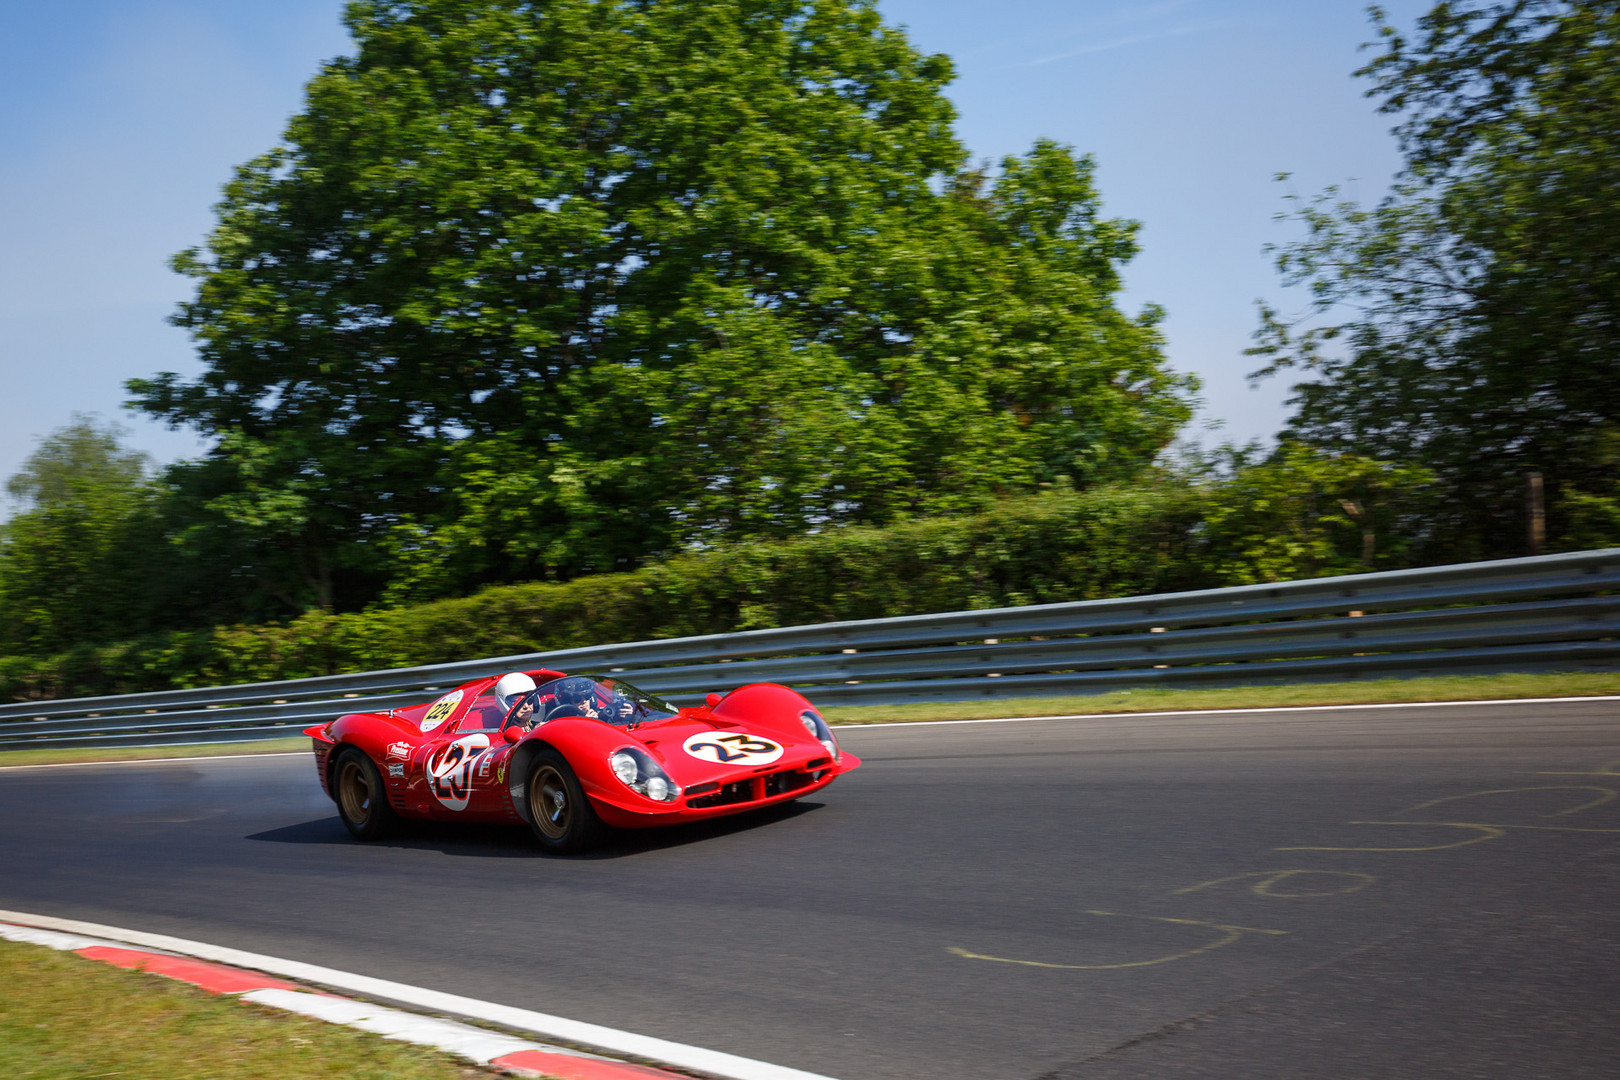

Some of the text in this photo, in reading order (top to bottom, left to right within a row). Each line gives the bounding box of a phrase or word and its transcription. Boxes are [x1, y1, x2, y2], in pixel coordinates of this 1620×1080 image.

[426, 703, 455, 719] 224
[689, 734, 777, 763] 23
[434, 745, 489, 801] 23
